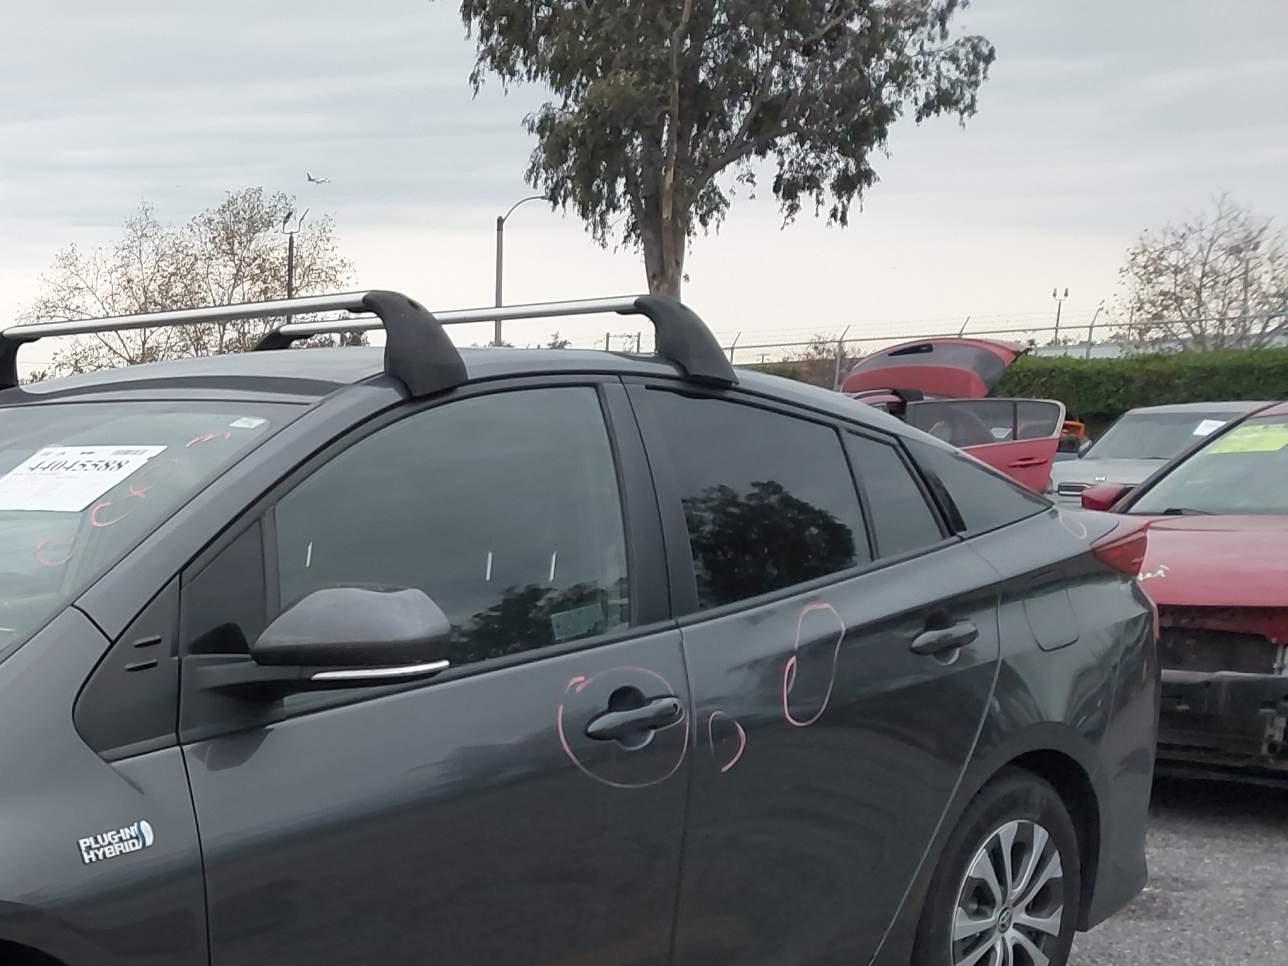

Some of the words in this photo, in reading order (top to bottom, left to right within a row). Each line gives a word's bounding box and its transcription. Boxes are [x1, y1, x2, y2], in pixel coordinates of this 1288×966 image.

[28, 459, 130, 472] 44045588
[78, 823, 137, 851] PLUG-IN
[82, 839, 142, 864] HYBRID
